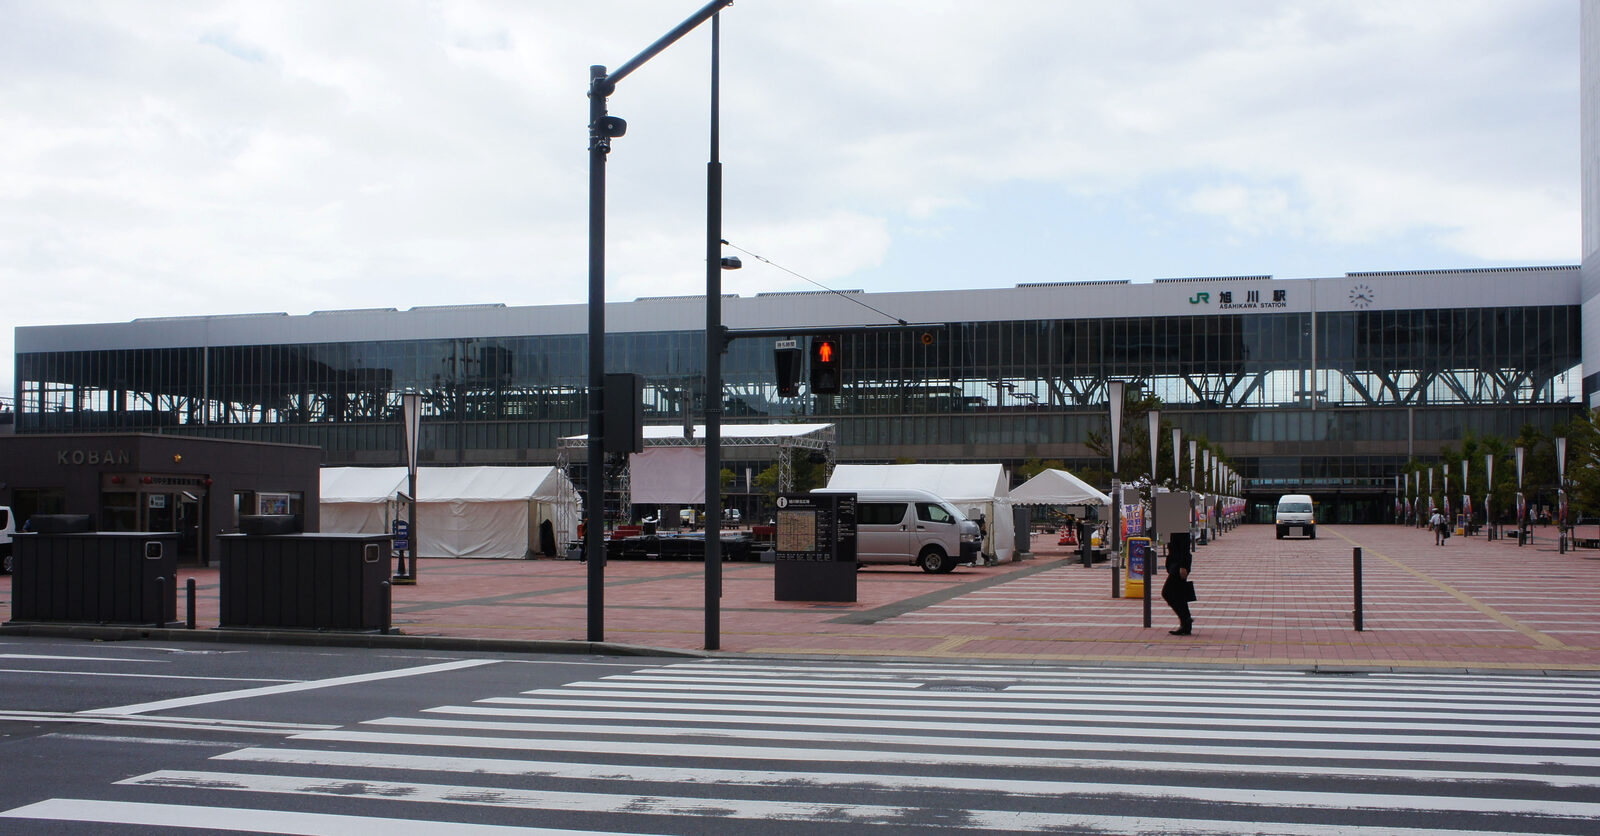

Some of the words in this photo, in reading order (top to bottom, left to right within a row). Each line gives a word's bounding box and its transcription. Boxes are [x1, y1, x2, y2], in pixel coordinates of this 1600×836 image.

[1189, 292, 1210, 304] JR
[1219, 290, 1286, 303] 旭川駅
[57, 450, 131, 465] KOBAN
